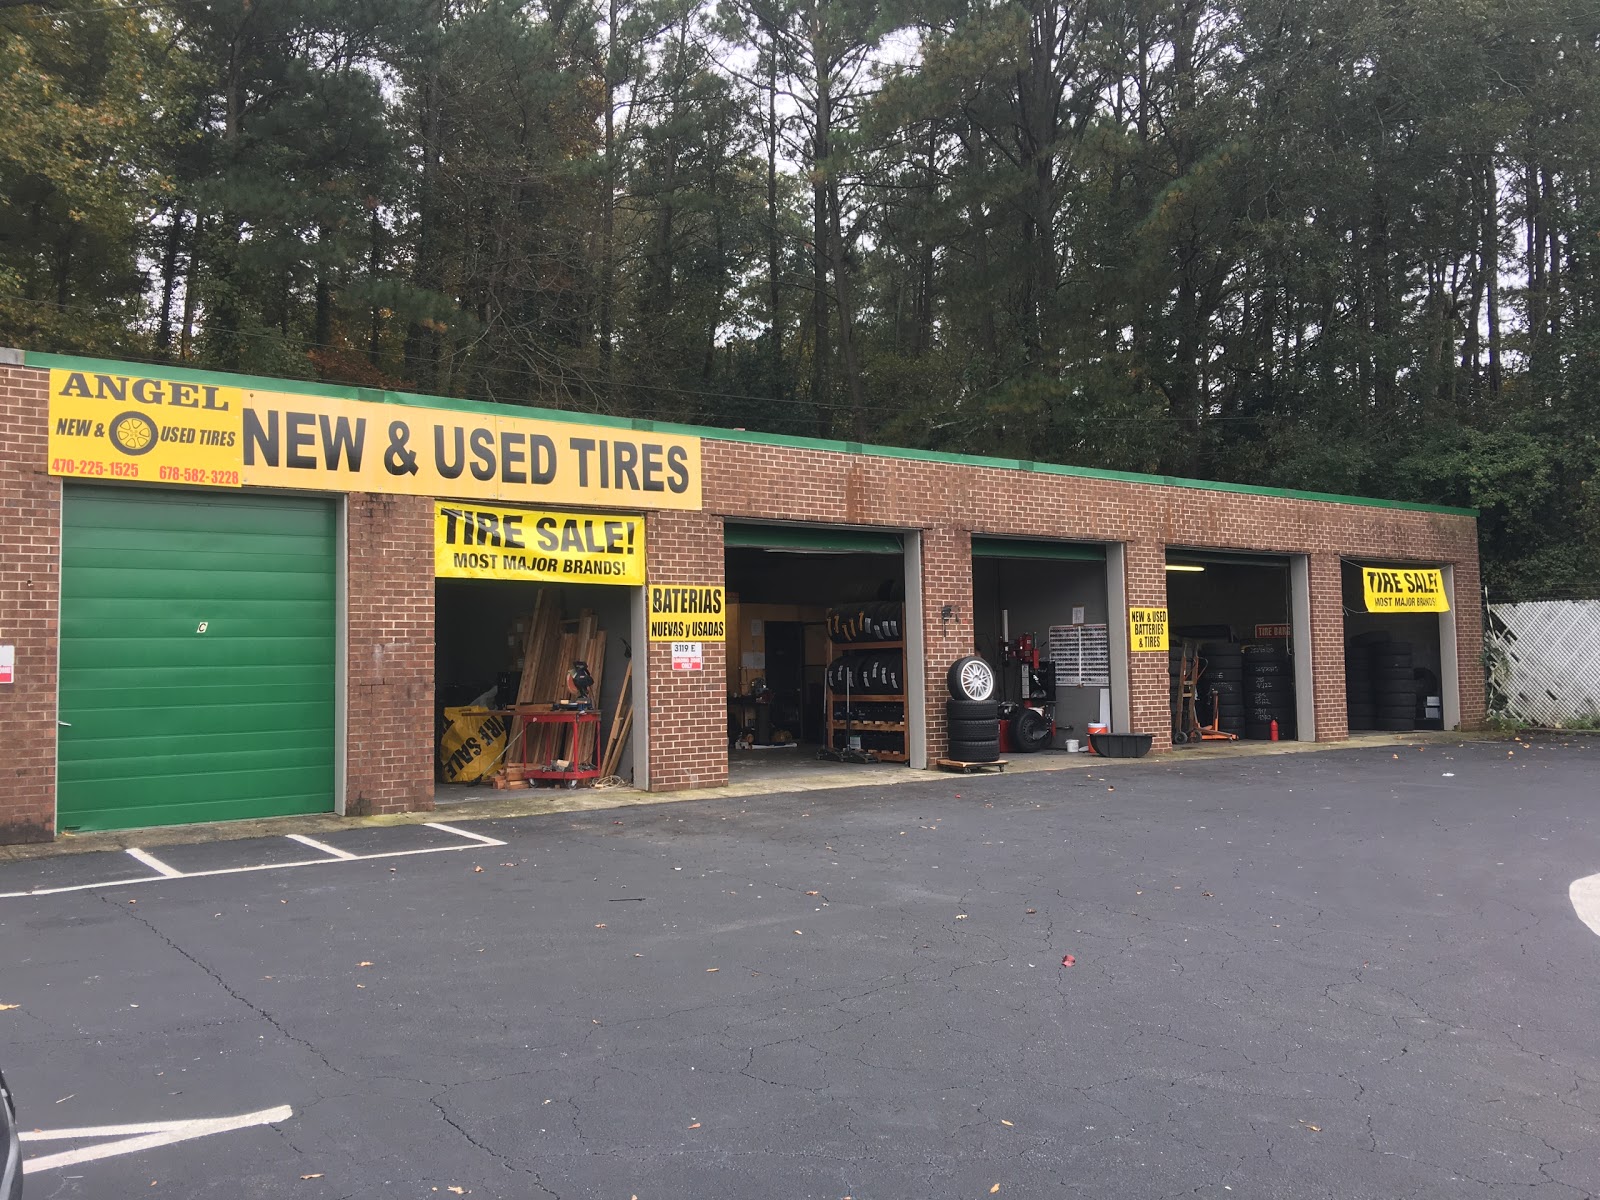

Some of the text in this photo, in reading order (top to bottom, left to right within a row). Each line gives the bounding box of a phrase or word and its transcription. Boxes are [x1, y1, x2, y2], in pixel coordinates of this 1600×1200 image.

[58, 372, 229, 411] ANGEL
[56, 418, 236, 447] NEW & USED TIRES
[242, 408, 689, 494] NEW & USED TIRES
[52, 458, 239, 485] 470-225-1525 678-582-3228
[440, 507, 635, 555] TIRE SALE!
[453, 552, 626, 576] MOST MAJOR BRANDS!
[1366, 571, 1439, 594] TIRE SALE!
[652, 588, 722, 614] BATERIAS
[1374, 597, 1393, 607] MOST
[1394, 597, 1416, 607] MAJOR
[1131, 611, 1166, 622] NEW & USED
[651, 621, 684, 637] NUEVAS
[692, 621, 724, 637] USADAS
[1134, 623, 1164, 635] BATTERIES
[1258, 627, 1273, 636] TIRE
[674, 644, 696, 652] 3119 E
[1138, 636, 1161, 648] & TIRES
[478, 715, 505, 746] IRE
